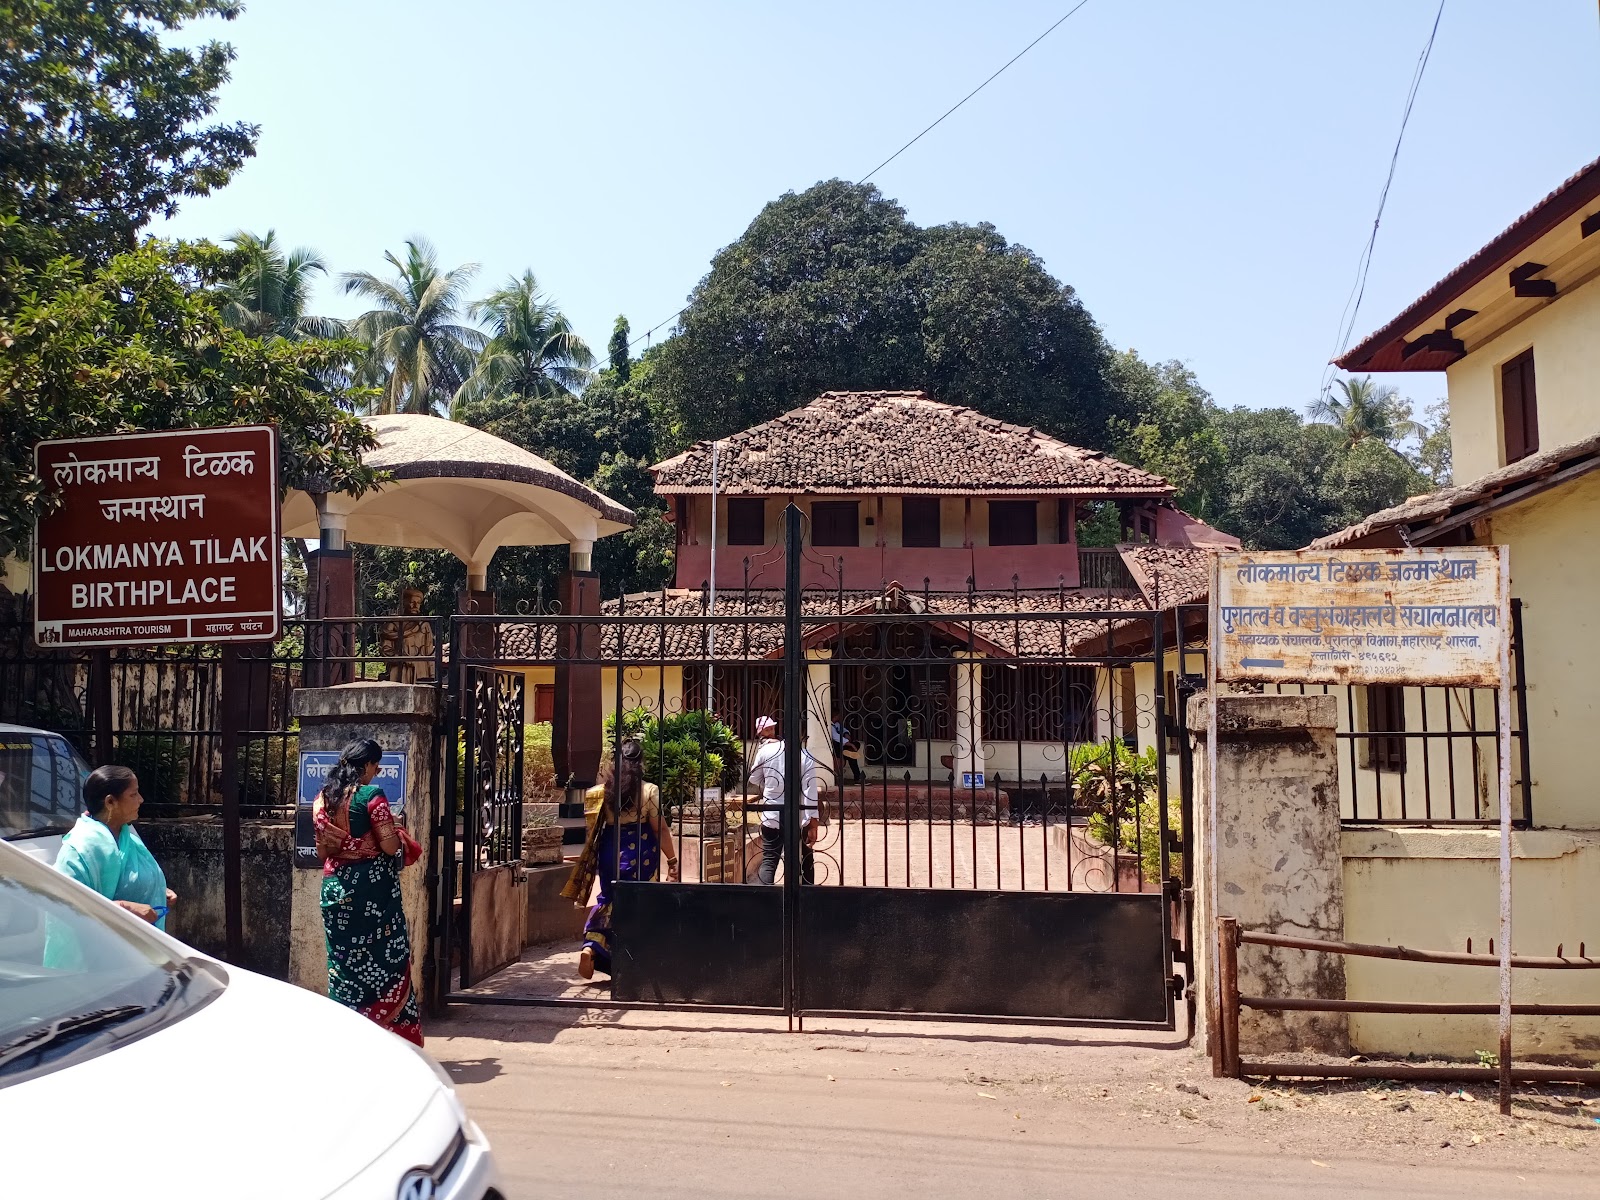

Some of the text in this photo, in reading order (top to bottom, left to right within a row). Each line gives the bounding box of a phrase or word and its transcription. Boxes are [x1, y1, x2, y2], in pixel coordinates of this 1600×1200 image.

[51, 444, 256, 487] लोकमान्य टिळक
[98, 493, 207, 523] जन्मस्थान
[41, 536, 268, 573] LOKMANYA TILAK
[1236, 557, 1478, 586] लोकमान्य टिळक जन्मस्थान
[71, 577, 236, 609] BIRTHPLACE
[68, 624, 172, 638] MAHARASHTRA TOURISM
[205, 618, 263, 633] महाराष्ट्र पर्यटन
[1221, 606, 1272, 634] पुरातत्व
[1273, 606, 1286, 627] व
[1399, 601, 1497, 629] संचालनालय
